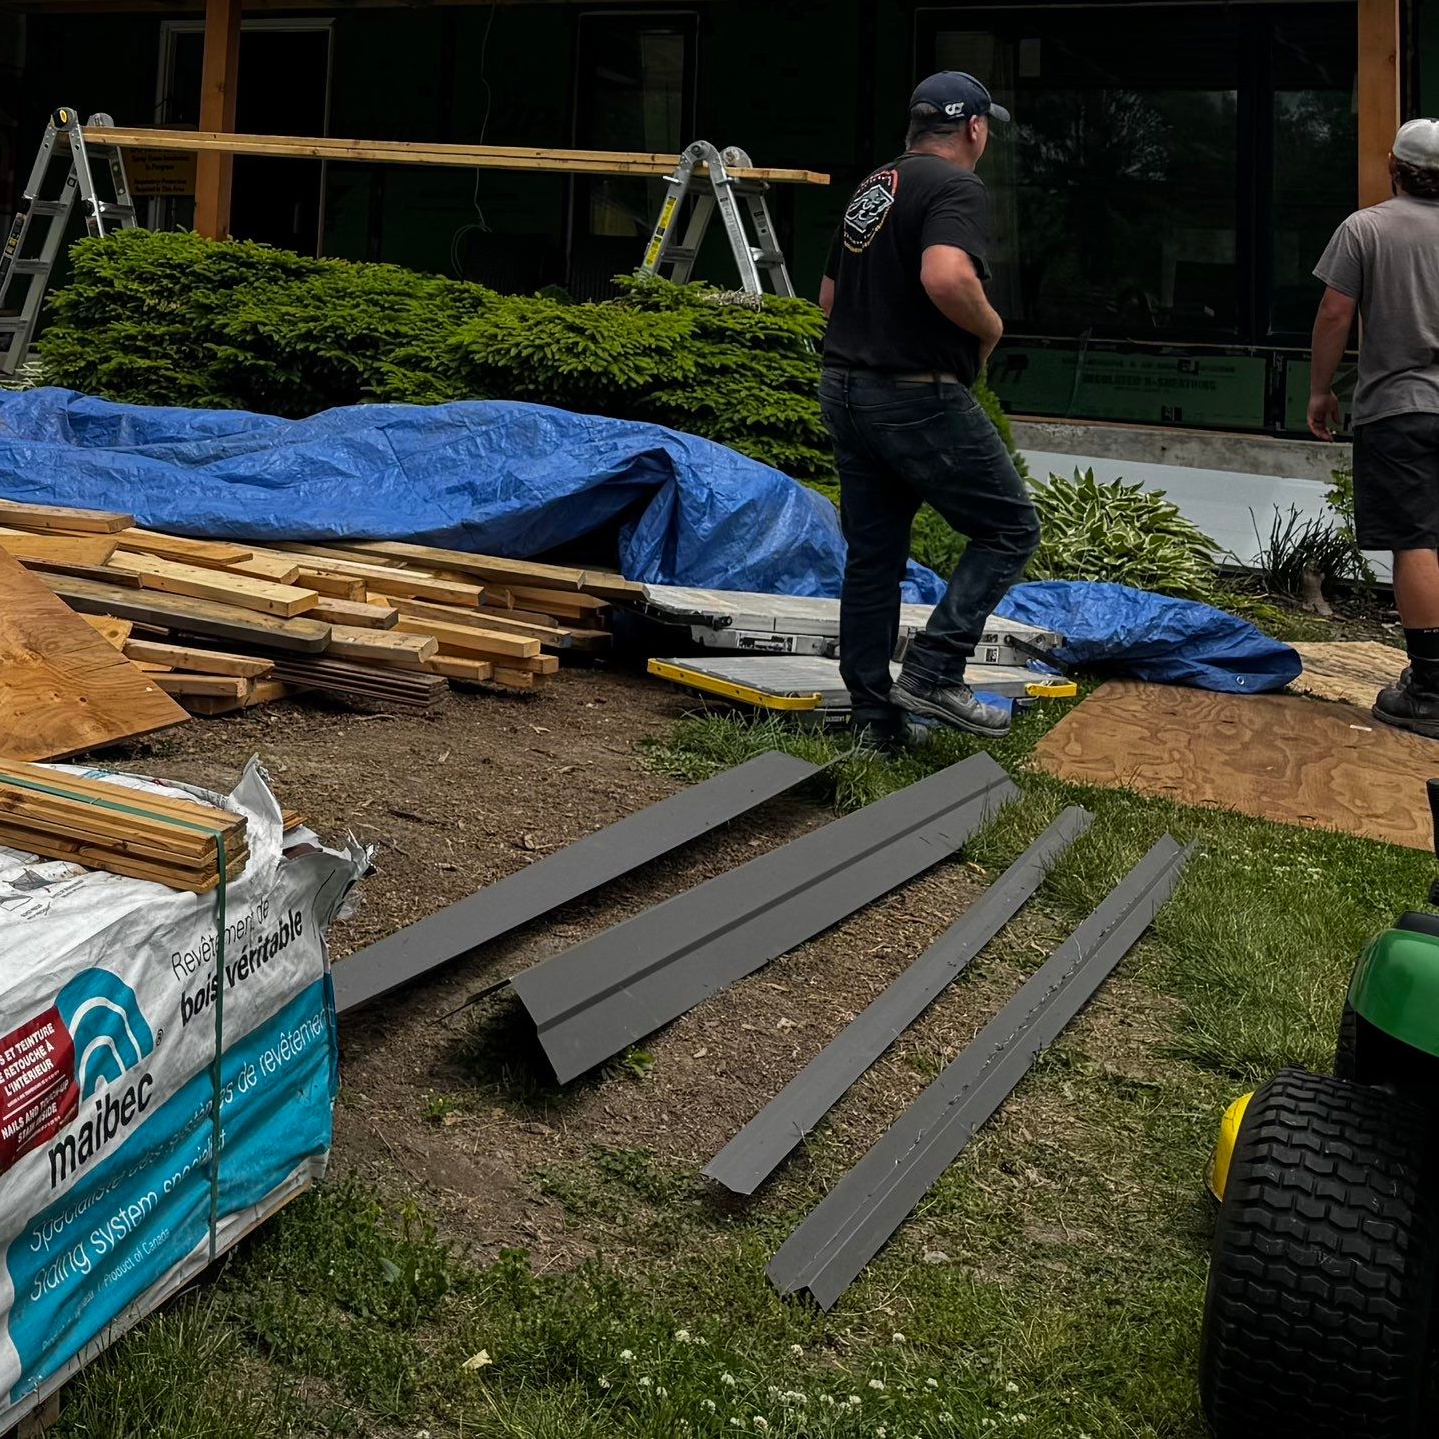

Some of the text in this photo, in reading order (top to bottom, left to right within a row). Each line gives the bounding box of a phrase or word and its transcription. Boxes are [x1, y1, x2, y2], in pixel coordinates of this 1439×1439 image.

[171, 911, 254, 981] Revêtment
[225, 908, 303, 989] véritable
[5, 1048, 16, 1061] ET
[17, 1022, 55, 1054] TEINTURE
[5, 1044, 46, 1080] RETOUCHE
[45, 1038, 55, 1051] À
[4, 1058, 54, 1097] L'INTÉRIEUR
[237, 1060, 258, 1094] de
[1, 1116, 25, 1140] NAILS
[25, 1104, 40, 1124] AND
[48, 1072, 153, 1190] maibec
[30, 1241, 92, 1302] siding
[90, 1190, 158, 1256] system
[104, 1256, 136, 1287] Product
[142, 1228, 170, 1256] Canada
